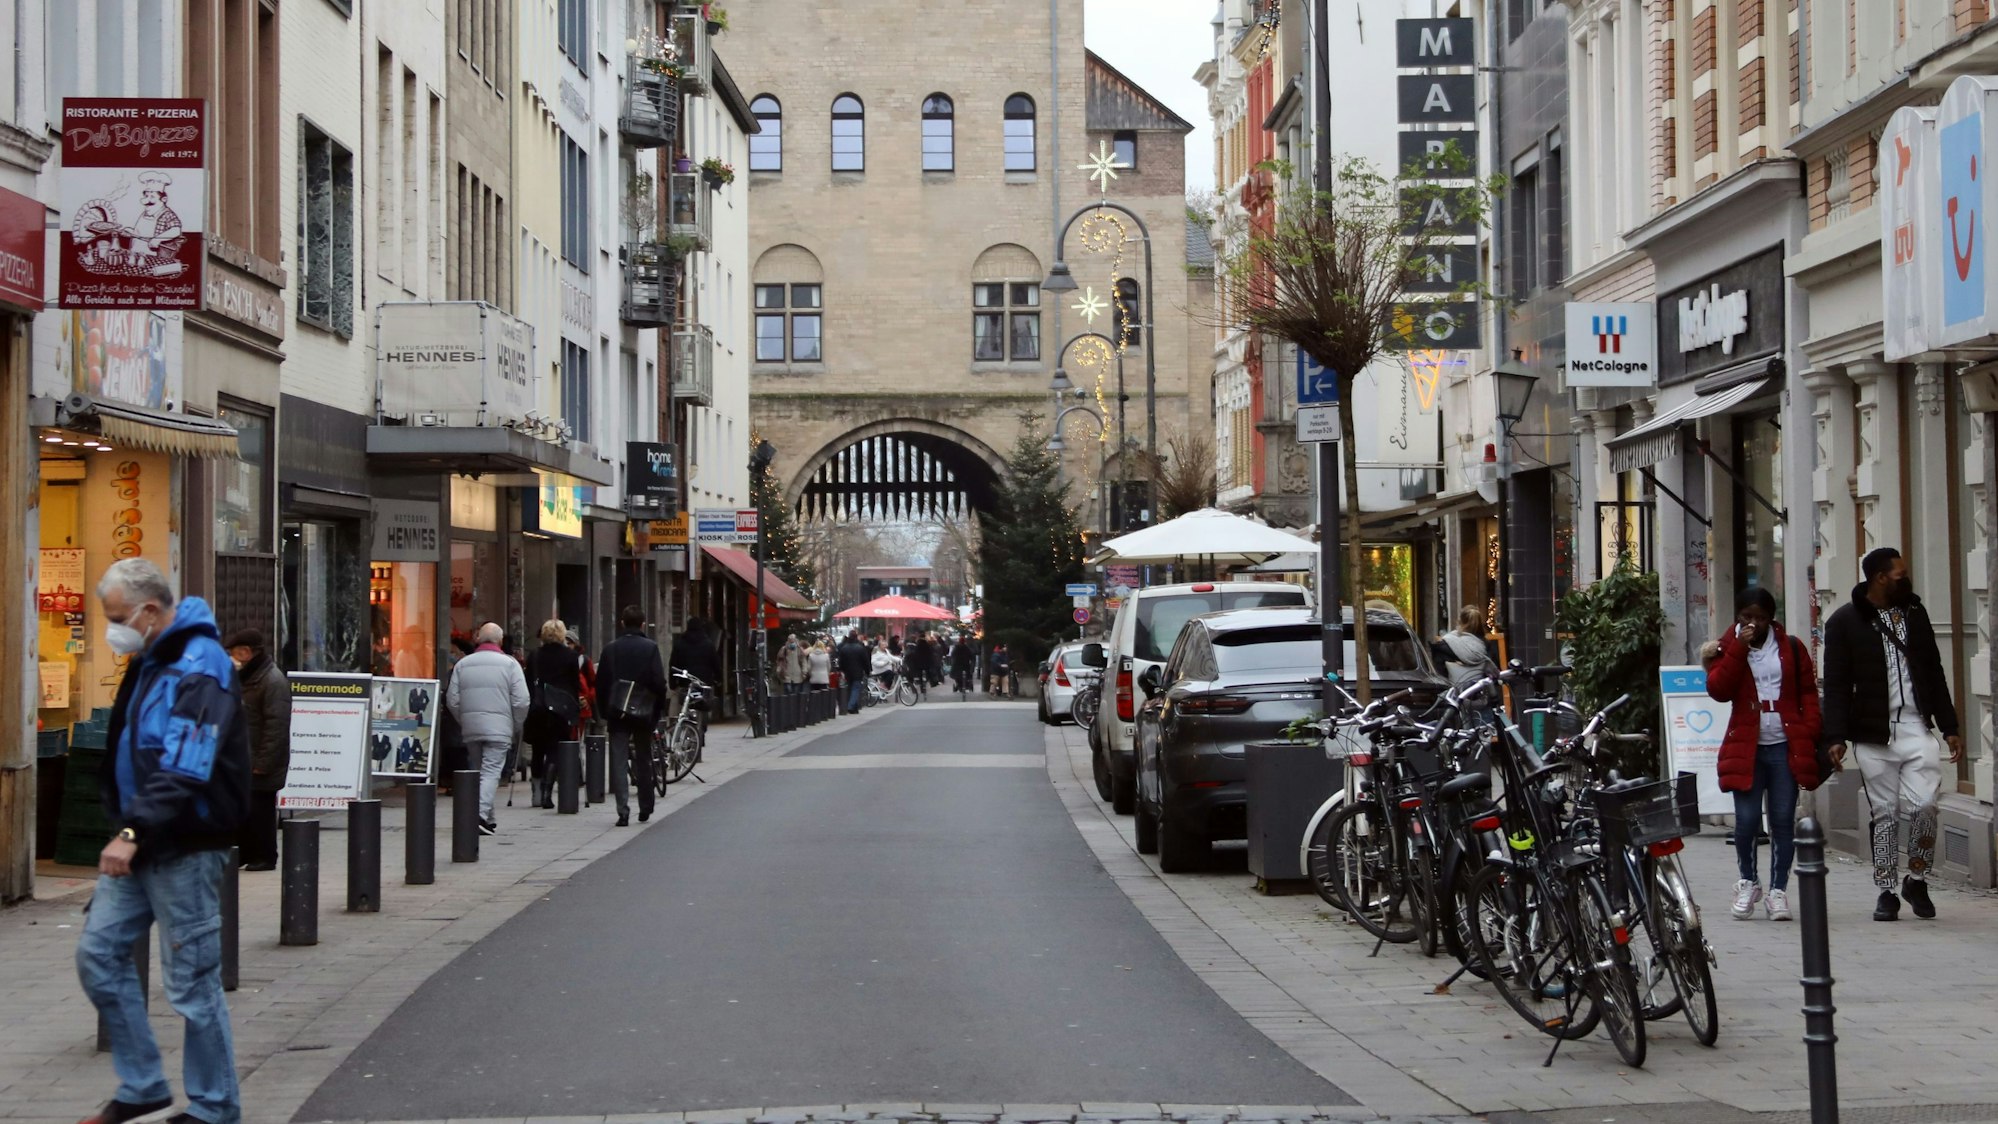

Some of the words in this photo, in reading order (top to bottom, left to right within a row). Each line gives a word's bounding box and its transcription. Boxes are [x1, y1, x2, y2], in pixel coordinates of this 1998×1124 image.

[66, 108, 138, 118] RISTORANTE
[147, 109, 198, 118] PIZZERIA
[66, 124, 111, 151] Del
[110, 123, 198, 157] Bajazzo
[65, 282, 98, 293] Pizza
[65, 295, 82, 304] Alle
[85, 295, 115, 304] Gerichte
[224, 280, 253, 321] ESCH
[387, 352, 476, 362] HENNES
[1572, 360, 1648, 373] NetCologne
[387, 527, 436, 550] HENNES
[291, 683, 363, 694] Herrenmode
[320, 798, 349, 807] EXPRES
